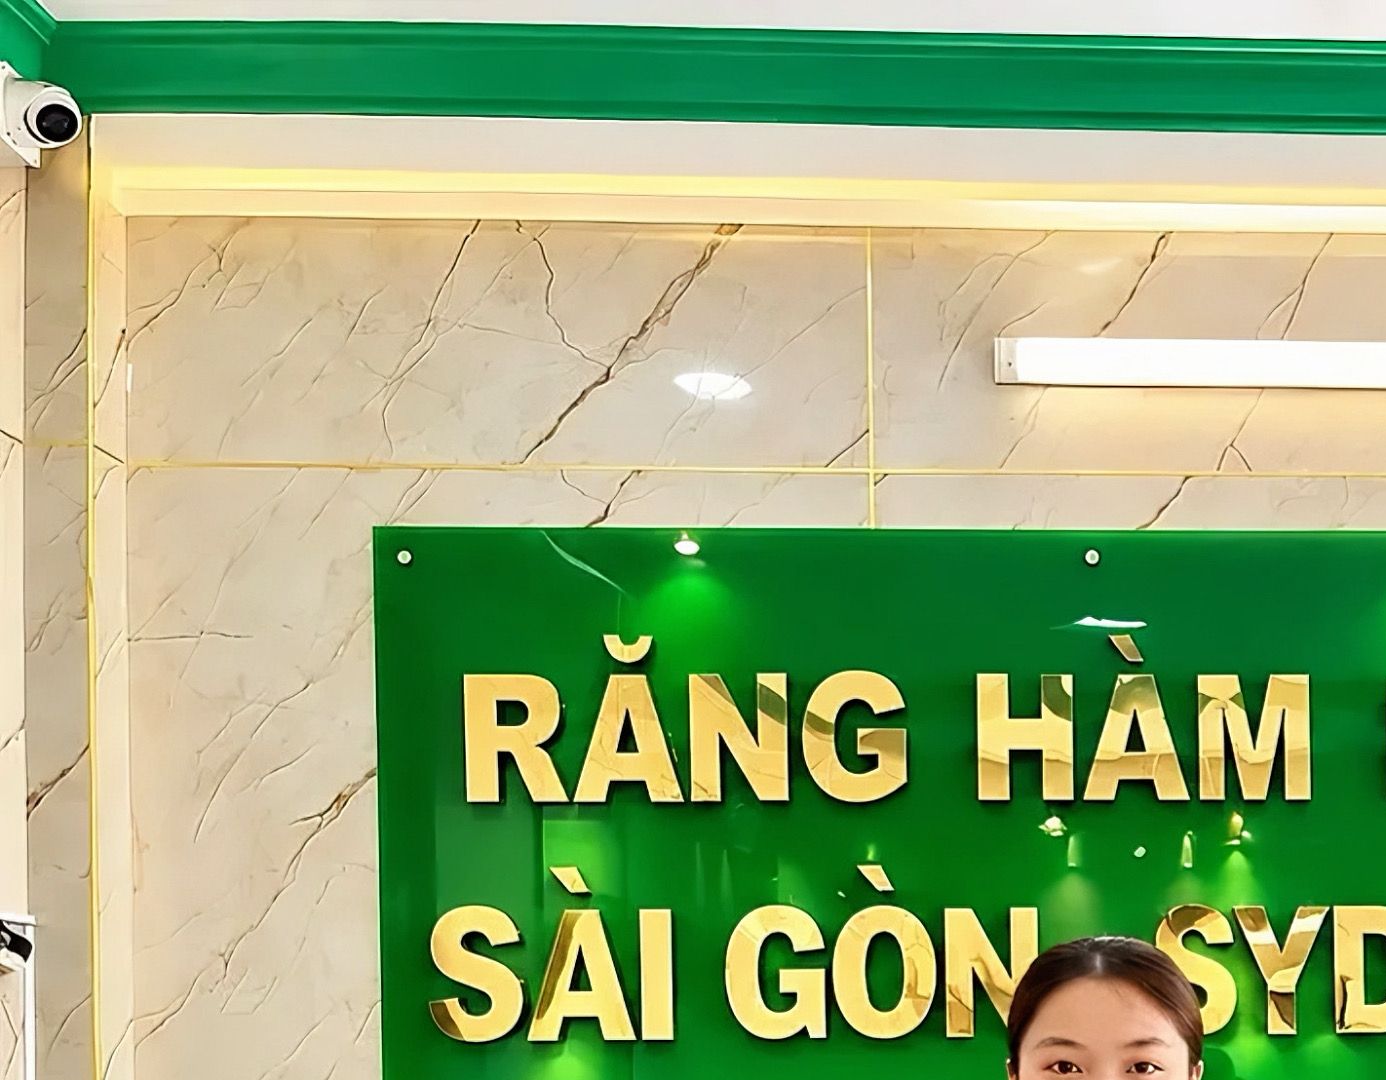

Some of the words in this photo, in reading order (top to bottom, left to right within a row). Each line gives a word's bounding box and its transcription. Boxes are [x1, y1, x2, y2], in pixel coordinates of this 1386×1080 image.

[463, 634, 909, 803] RĂNG
[976, 633, 1312, 801] HÀM
[429, 865, 675, 1043] SÀI
[724, 864, 1039, 1040] GÒN
